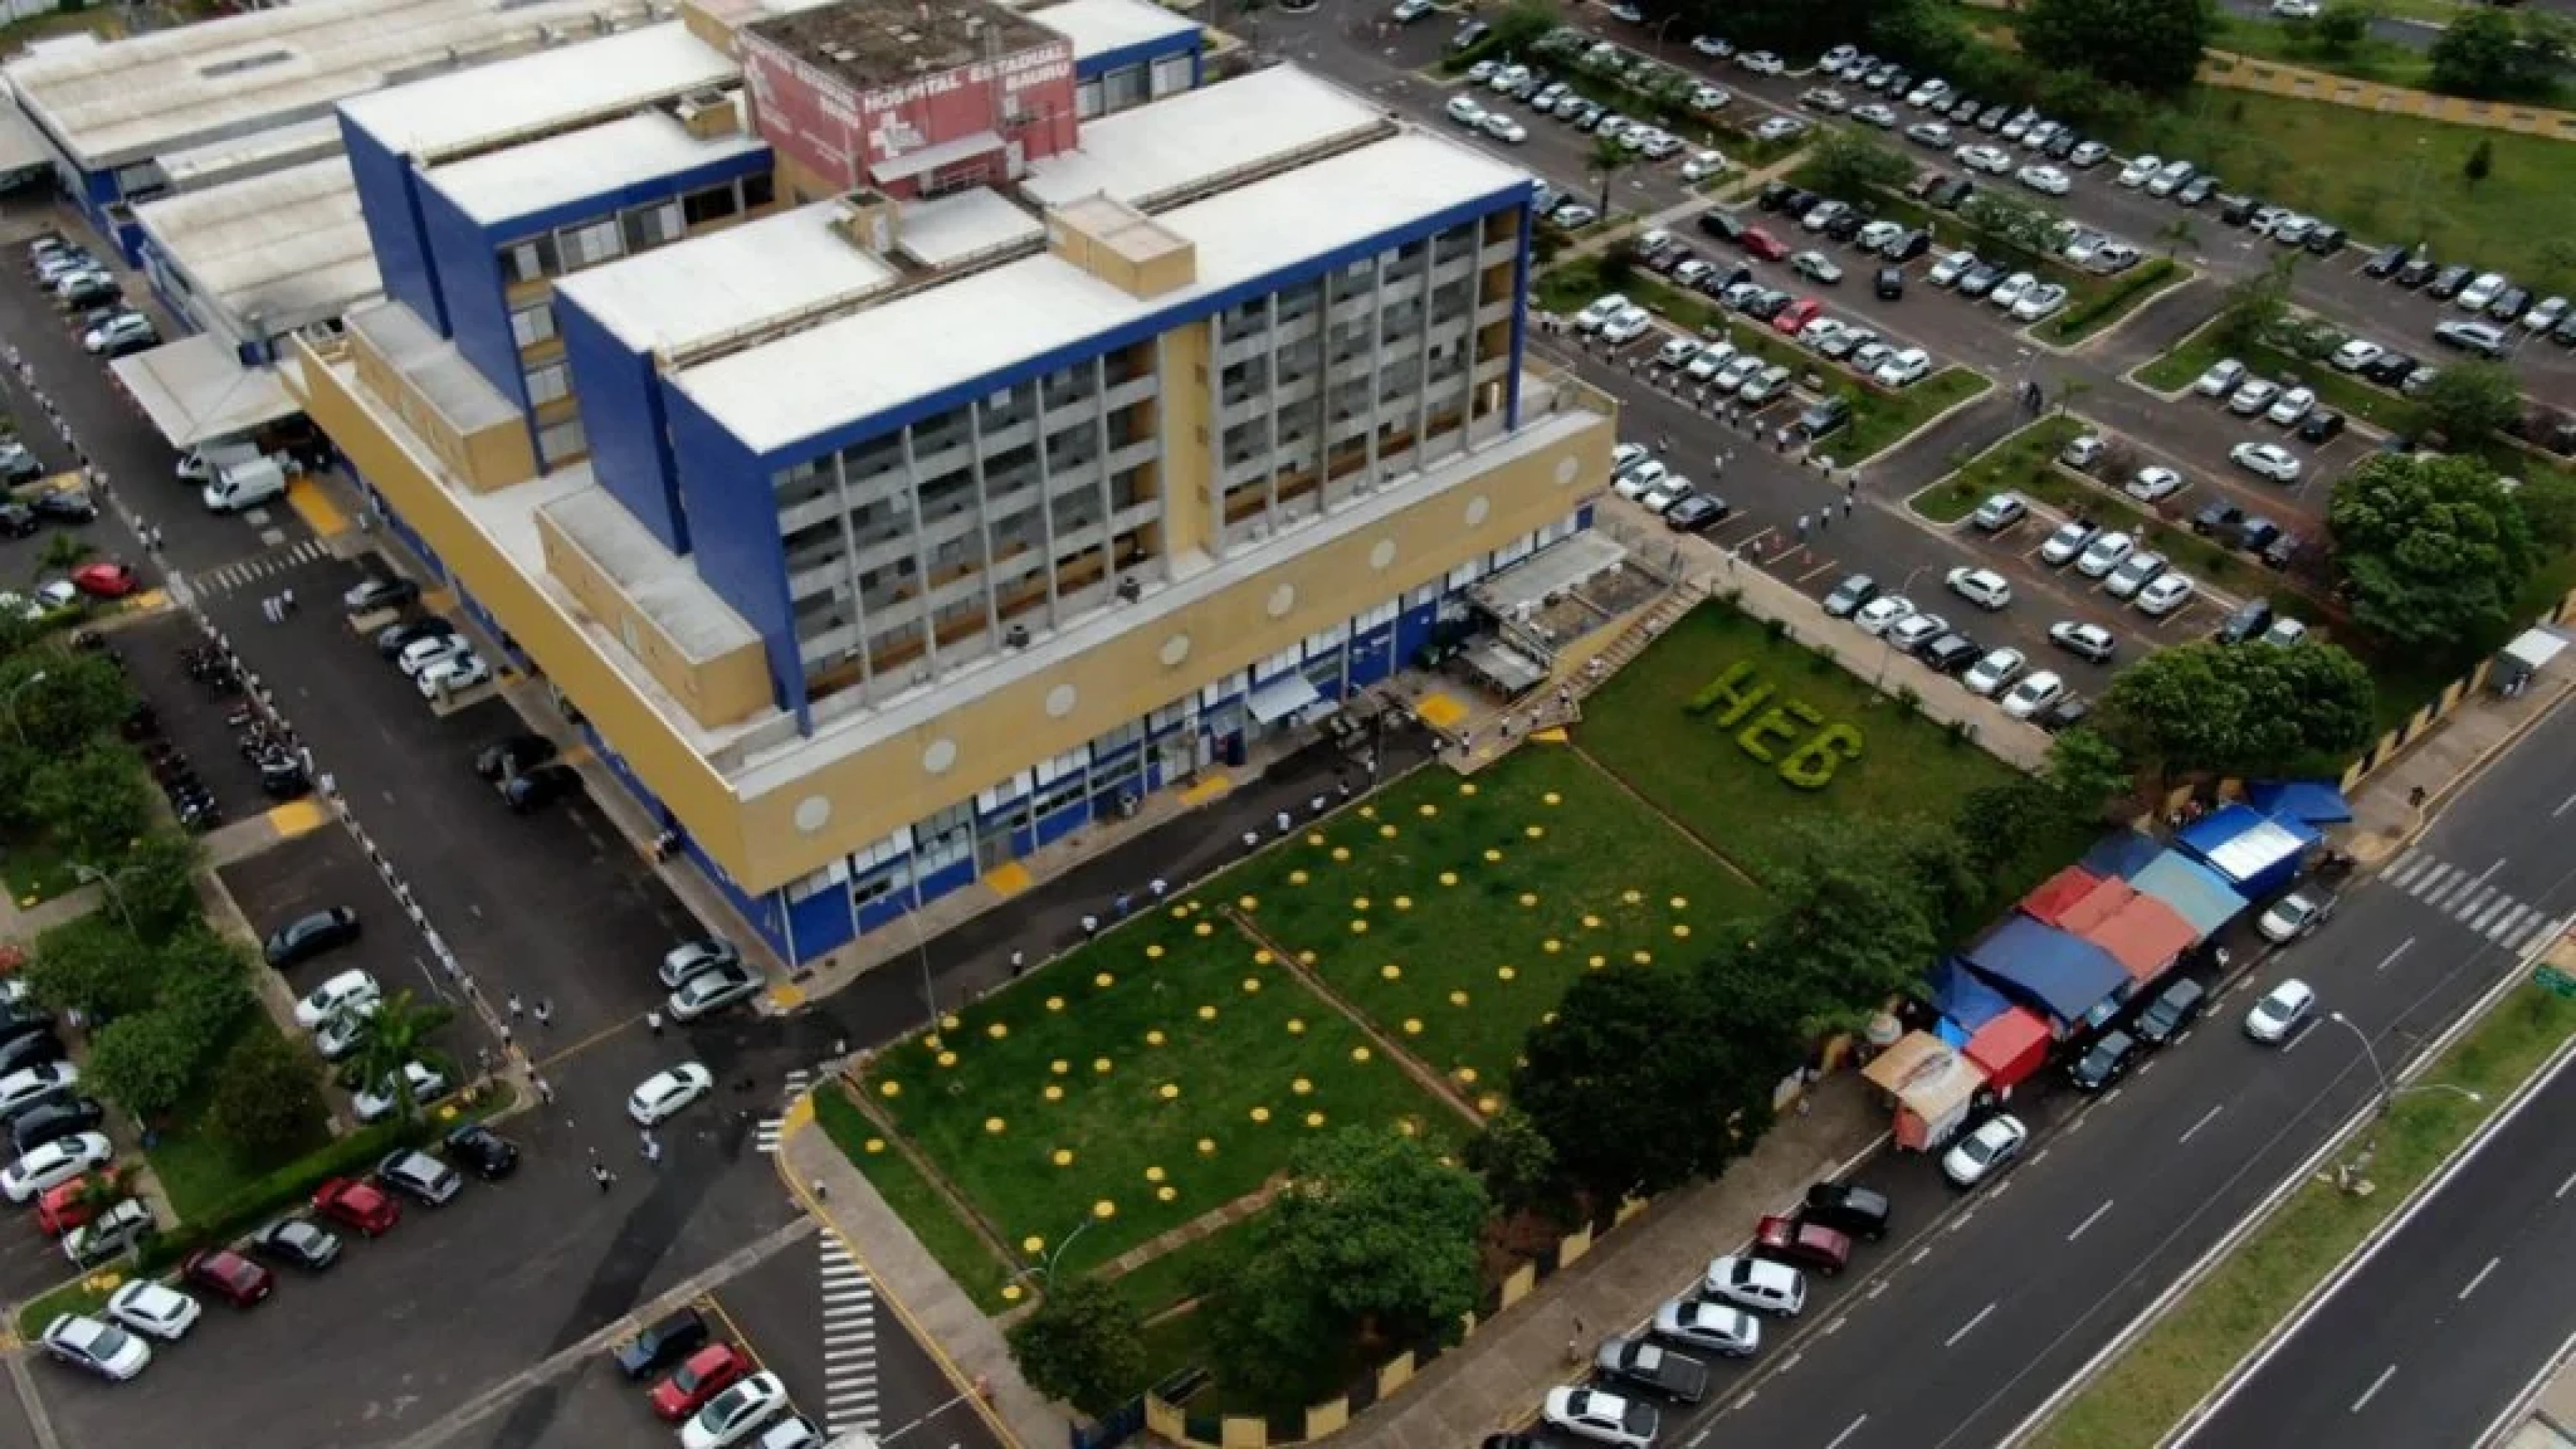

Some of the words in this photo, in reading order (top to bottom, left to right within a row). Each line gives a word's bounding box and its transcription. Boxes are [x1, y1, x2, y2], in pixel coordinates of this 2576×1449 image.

[864, 73, 962, 113] HOSPITAL
[969, 46, 1067, 82] ESTADUAL
[1005, 62, 1071, 91] BAURU
